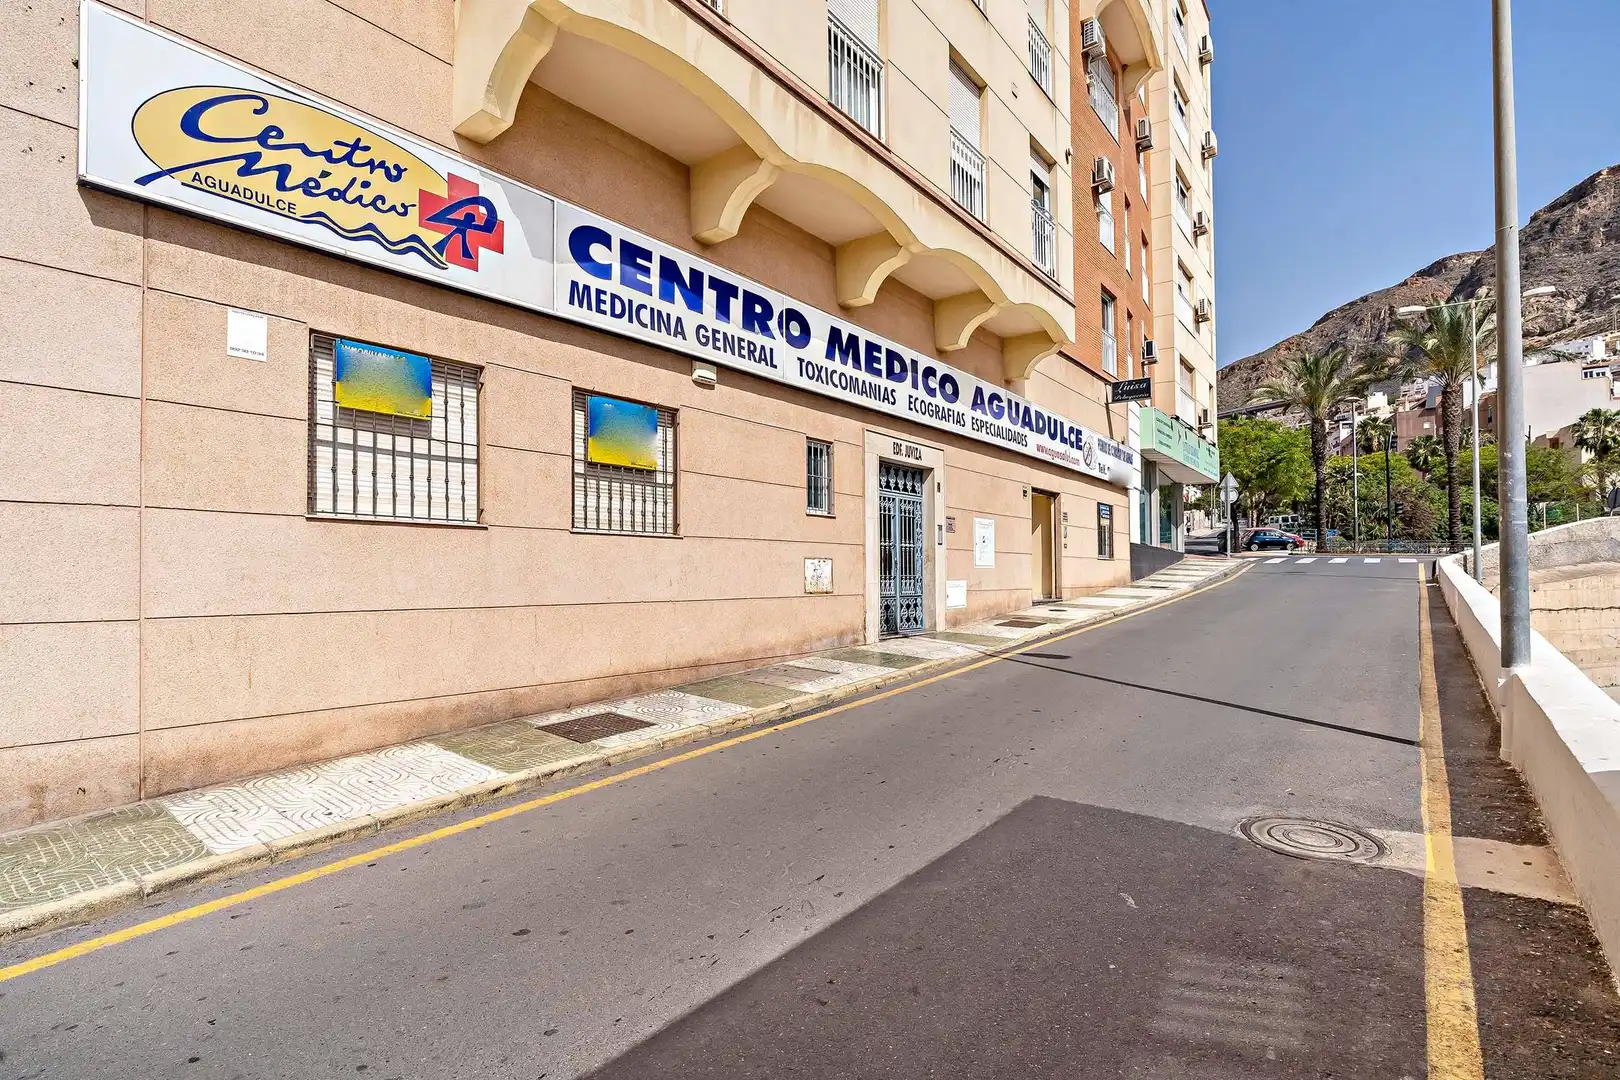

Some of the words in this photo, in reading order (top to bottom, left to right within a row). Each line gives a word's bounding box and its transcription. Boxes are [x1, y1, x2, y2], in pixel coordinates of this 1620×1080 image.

[180, 94, 408, 182] Centro
[134, 151, 417, 217] Médico
[191, 171, 297, 215] AGUADULCE
[568, 279, 687, 341] MEDICINA
[695, 323, 778, 369] GENERAL
[568, 225, 811, 349] CENTRO
[825, 325, 960, 404] MEDICO
[971, 385, 1083, 451] AGUADULCE
[797, 357, 897, 405] TOXICOMANIAS
[908, 394, 966, 427] ECOGRAFIAS
[971, 417, 1028, 447] ESPECIALIDADES
